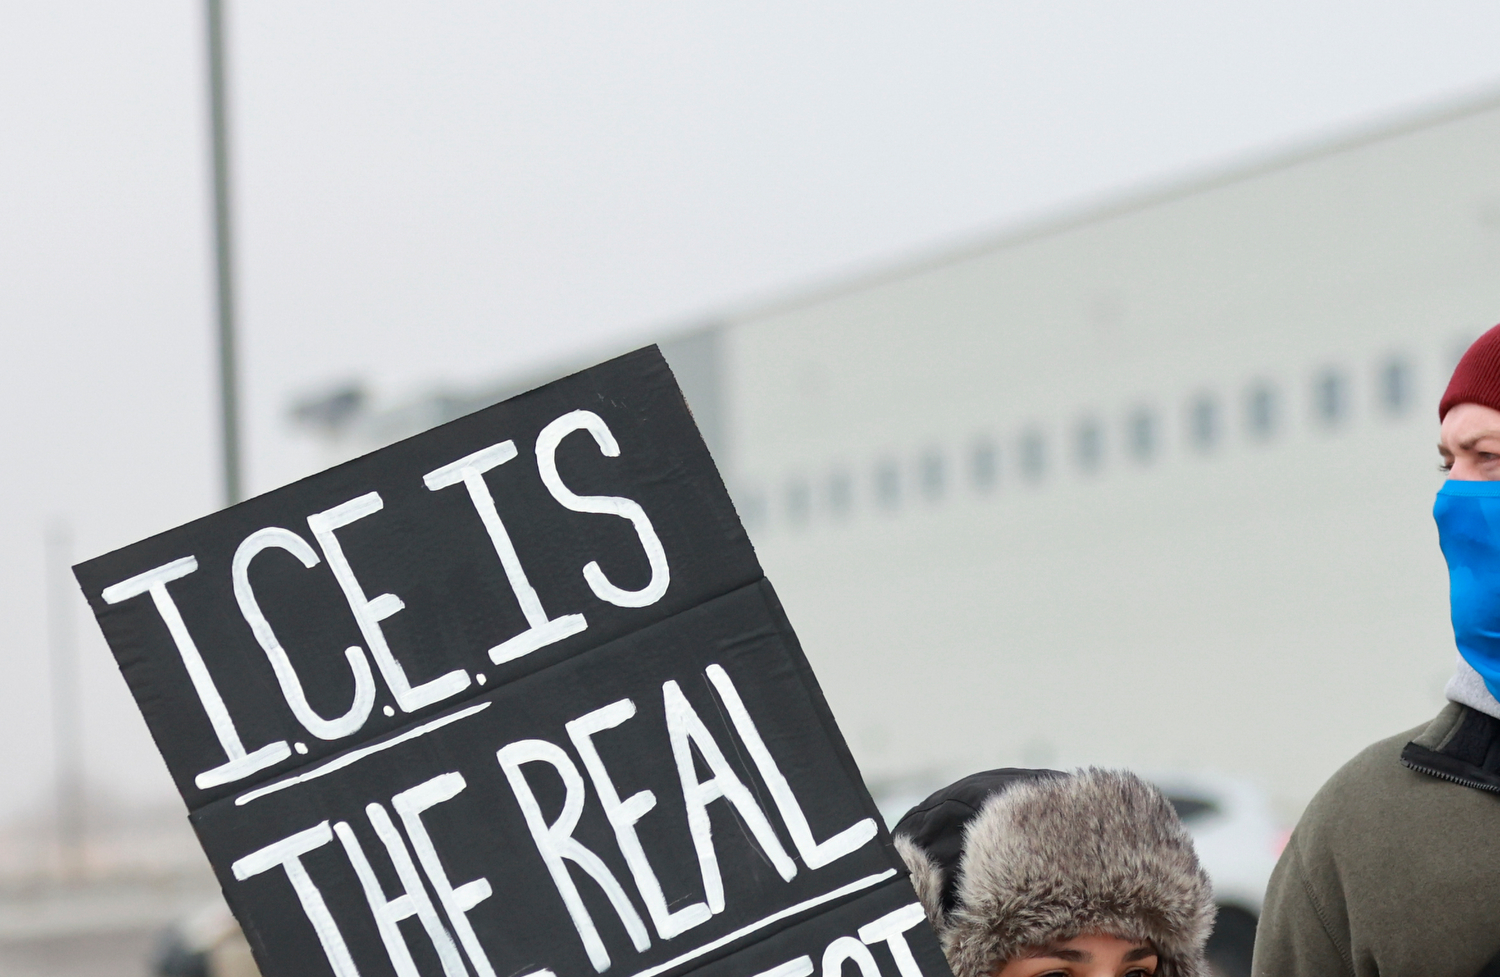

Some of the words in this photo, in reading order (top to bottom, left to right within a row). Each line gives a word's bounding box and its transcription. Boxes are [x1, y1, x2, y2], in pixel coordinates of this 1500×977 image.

[102, 492, 487, 789] I.C.E.
[423, 409, 671, 665] IS
[497, 664, 878, 973] REAL
